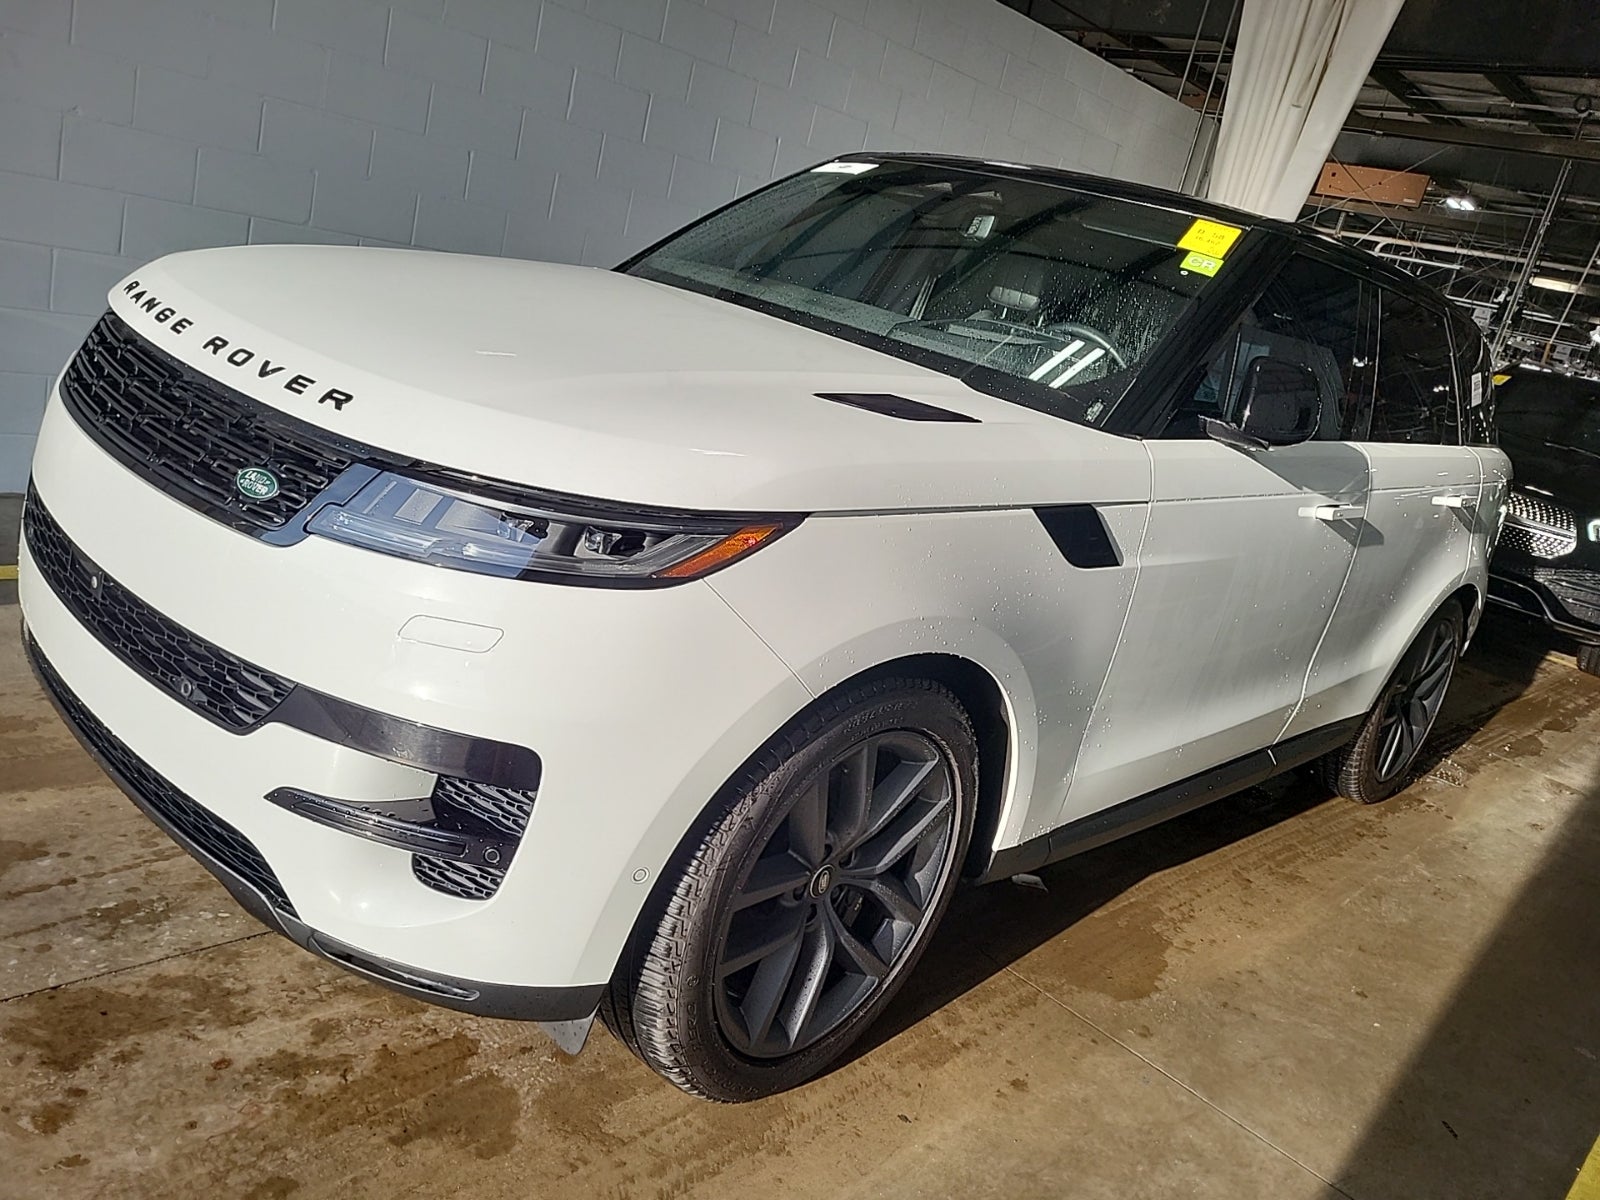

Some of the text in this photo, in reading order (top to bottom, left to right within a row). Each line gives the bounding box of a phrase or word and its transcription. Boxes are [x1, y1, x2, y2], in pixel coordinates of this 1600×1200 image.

[1187, 254, 1217, 271] CR
[123, 280, 354, 412] RANGE ROVER
[244, 470, 267, 484] LAND
[241, 479, 269, 496] ROVER
